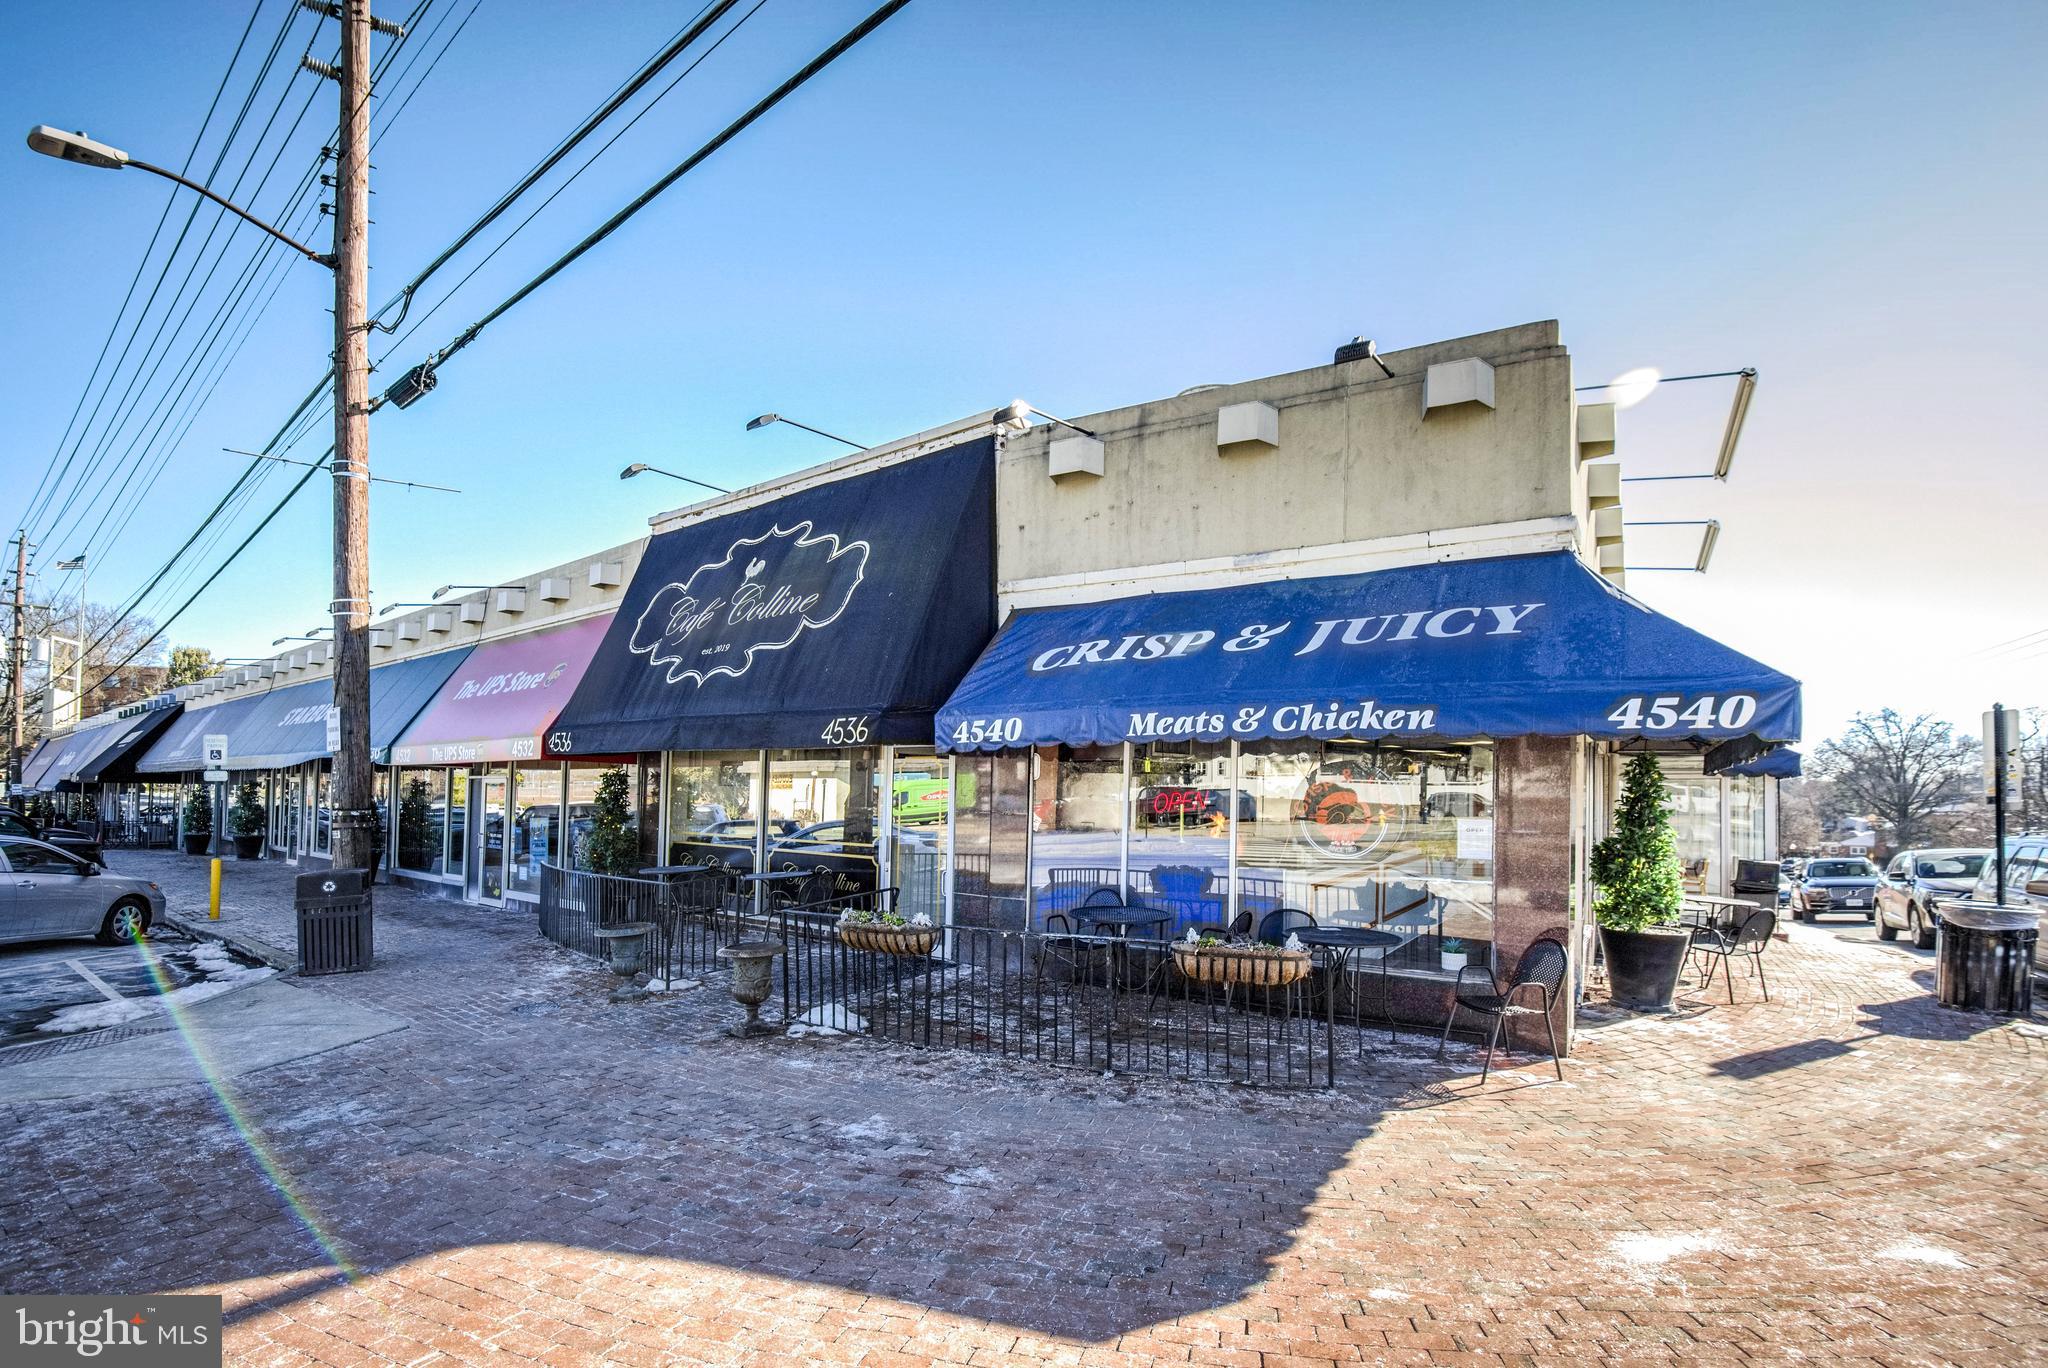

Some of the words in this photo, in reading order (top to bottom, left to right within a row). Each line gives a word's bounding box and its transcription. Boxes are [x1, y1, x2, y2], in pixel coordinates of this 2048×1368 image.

[666, 596, 726, 646] Café
[728, 583, 820, 625] Colline
[714, 643, 731, 654] 2019
[1032, 630, 1215, 671] CRISP
[1222, 621, 1291, 652] &
[1294, 603, 1546, 656] JUICY
[453, 680, 480, 700] The
[476, 673, 513, 696] UPS
[511, 671, 545, 691] Store
[278, 703, 334, 727] STARBU
[1126, 711, 1225, 737] Meats
[1232, 705, 1267, 732] &
[1272, 701, 1436, 732] Chicken
[1607, 695, 1757, 730] 4540
[548, 732, 571, 752] 4536
[821, 716, 869, 744] 4536
[953, 717, 1023, 744] 4540
[432, 747, 443, 761] The
[444, 746, 457, 760] UPS
[458, 745, 475, 760] Store
[512, 740, 534, 757] 4532
[1154, 790, 1209, 813] OPEN
